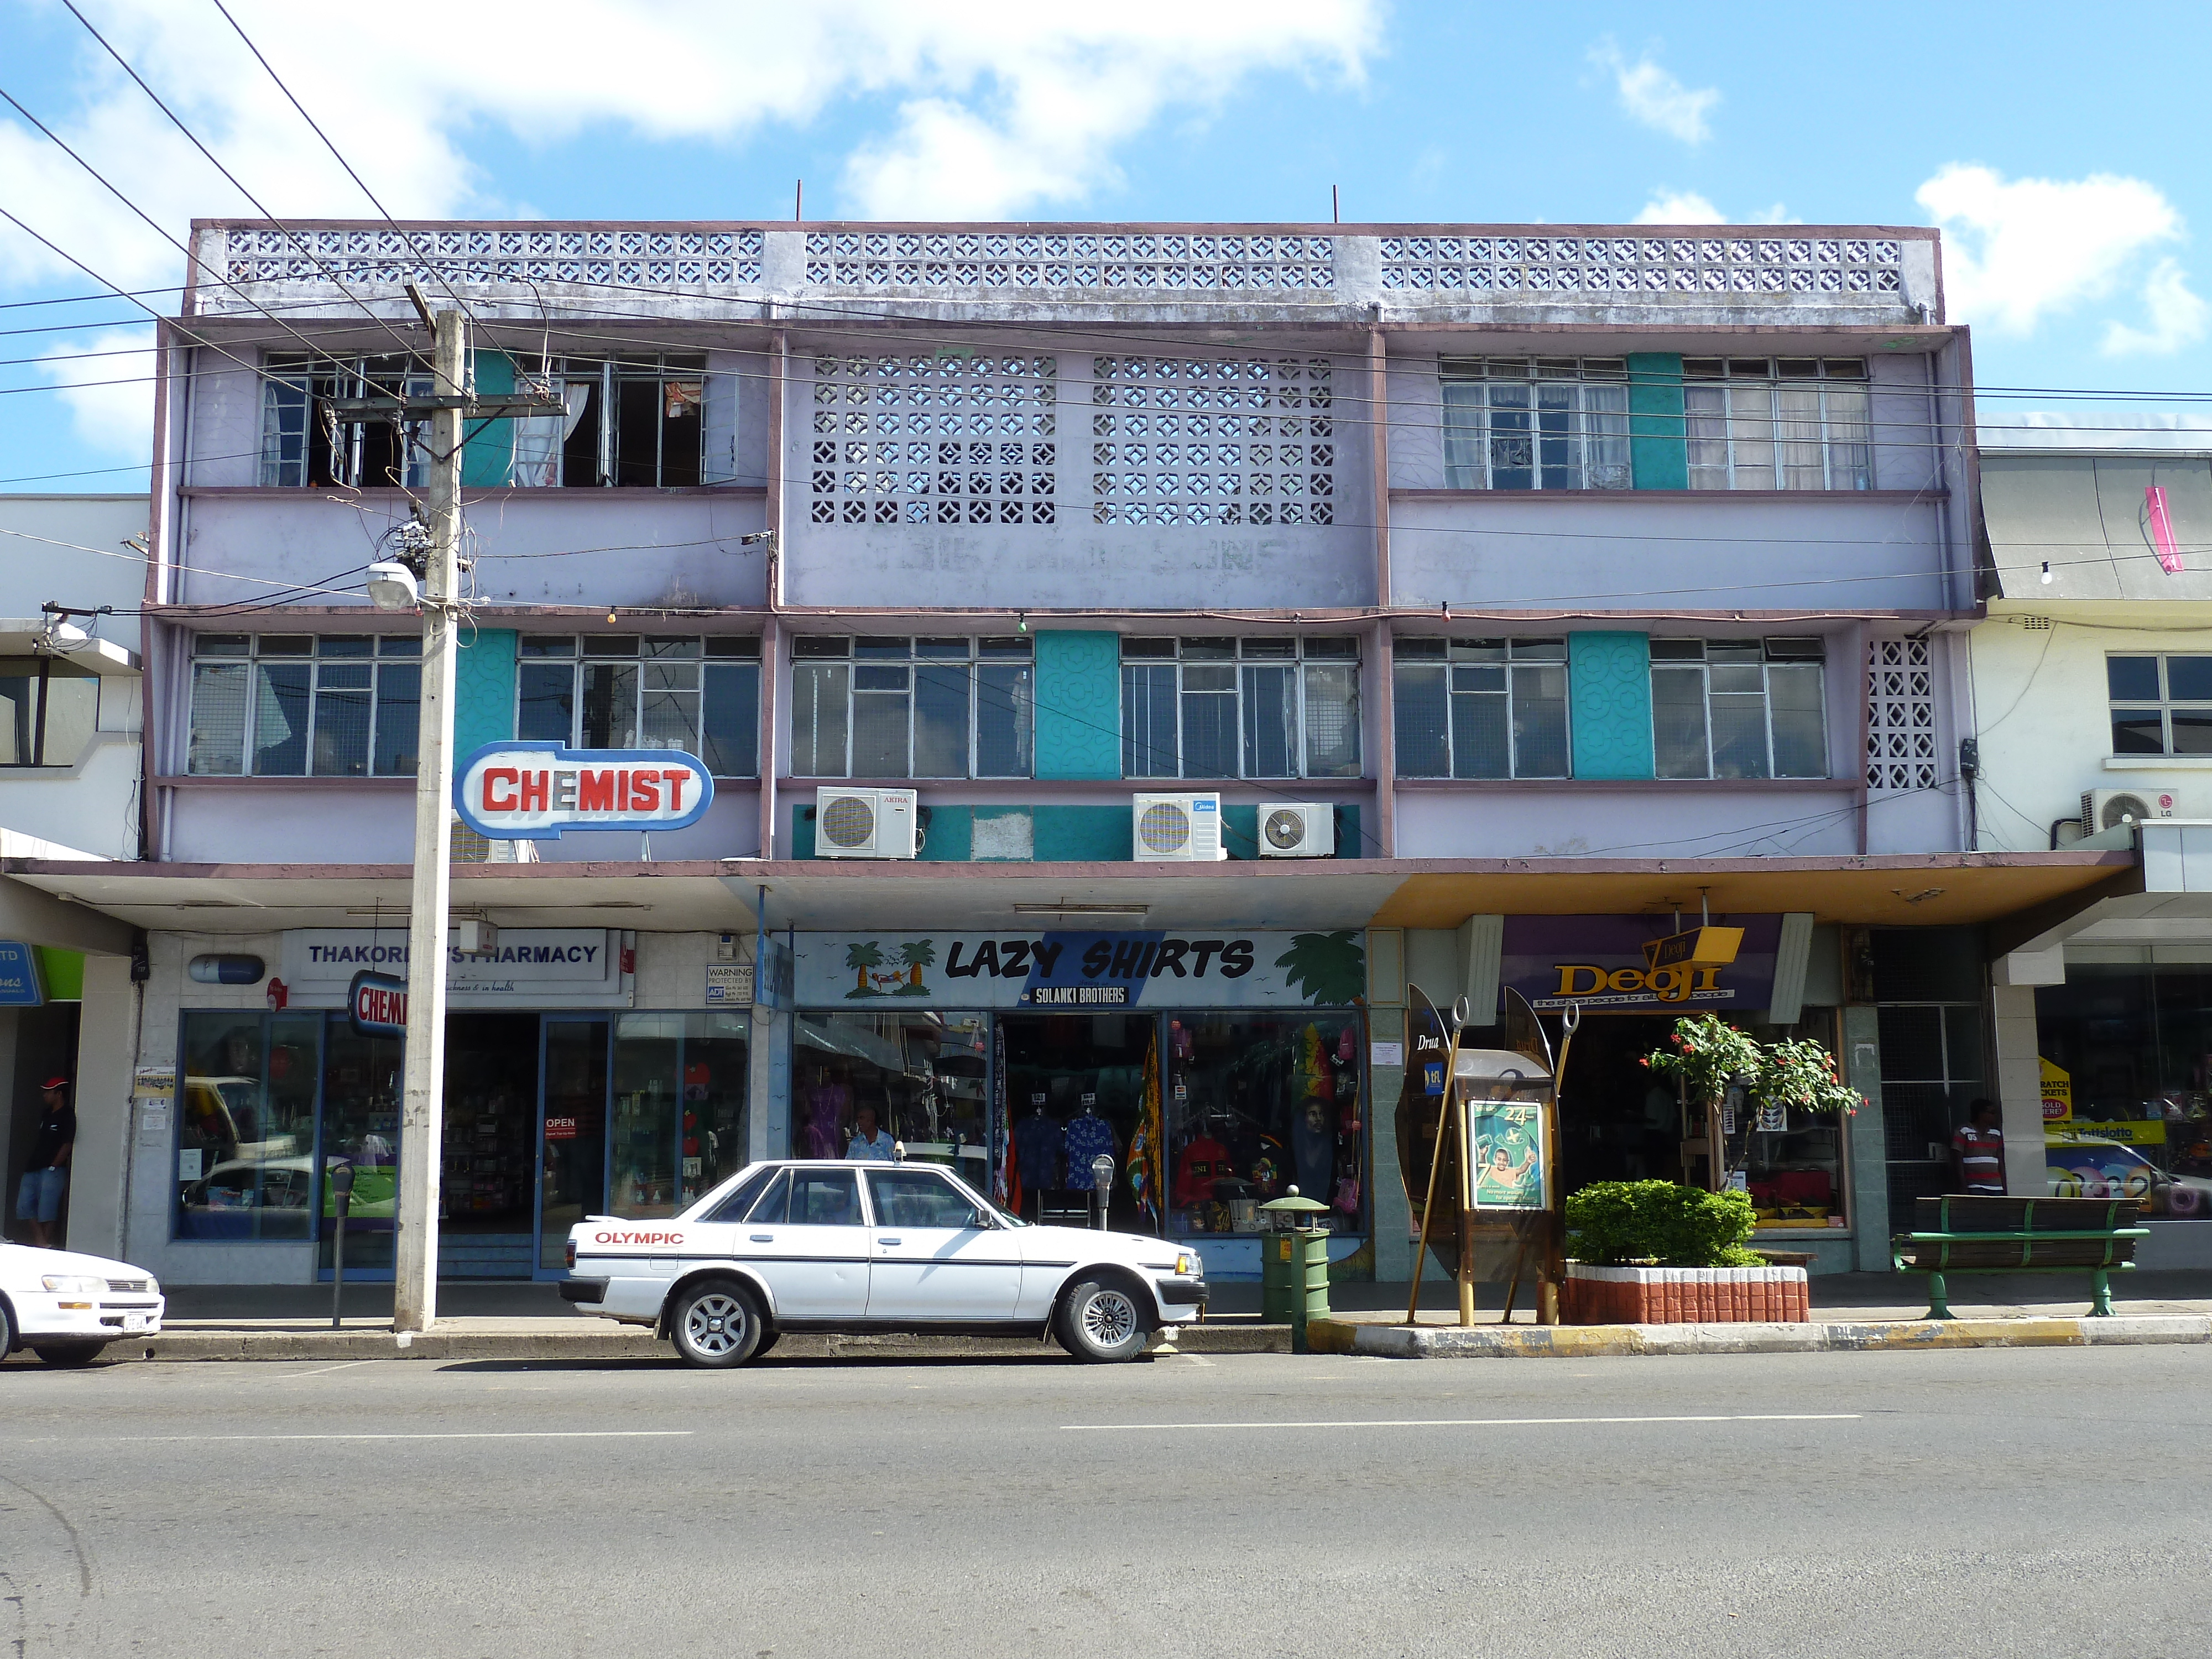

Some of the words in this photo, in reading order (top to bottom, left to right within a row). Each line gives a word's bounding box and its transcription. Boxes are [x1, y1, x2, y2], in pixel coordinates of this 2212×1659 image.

[482, 768, 691, 811] CHEMIST
[0, 951, 18, 961] TD
[471, 946, 597, 963] HARMACY
[945, 940, 1063, 978] LAZY
[1082, 939, 1255, 979] SHIRTS
[709, 968, 753, 977] WARNING
[492, 980, 514, 992] health
[1036, 987, 1077, 1004] SOLANKI
[1079, 987, 1125, 1004] BROTHERS
[1587, 995, 1625, 1005] people
[1691, 990, 1728, 999] people
[358, 987, 408, 1025] CHEMI
[1417, 1035, 1439, 1050] Drua
[546, 1118, 575, 1128] OPEN
[1504, 1107, 1526, 1125] 24
[2078, 1126, 2133, 1138] Tattslotto
[1477, 1163, 1491, 1185] 7
[595, 1233, 684, 1244] OLYMPIC
